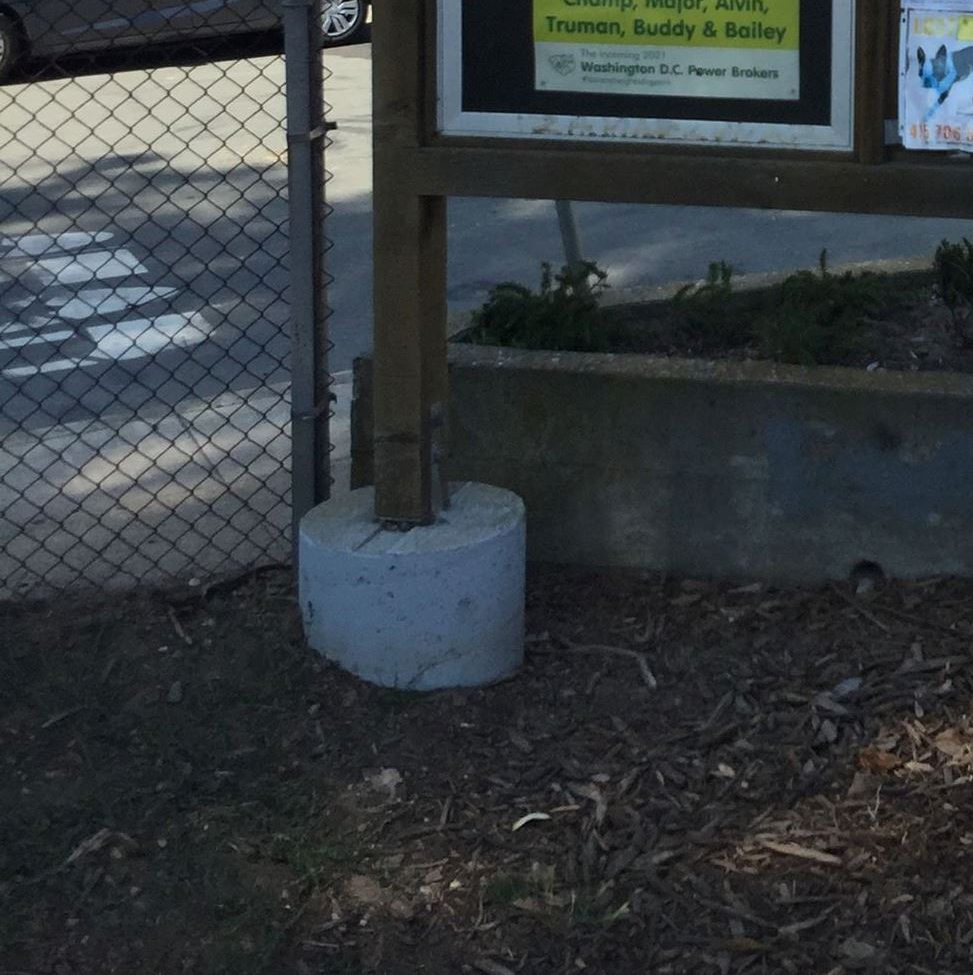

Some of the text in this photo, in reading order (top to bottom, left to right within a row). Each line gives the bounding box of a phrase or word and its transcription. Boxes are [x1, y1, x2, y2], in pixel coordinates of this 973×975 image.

[546, 15, 787, 43] Truman, Buddy & Bailey
[581, 49, 596, 58] The
[643, 51, 666, 60] 2021
[581, 62, 656, 77] Washington
[660, 64, 684, 76] D.C.
[688, 66, 726, 77] Power
[731, 67, 779, 79] Brokers
